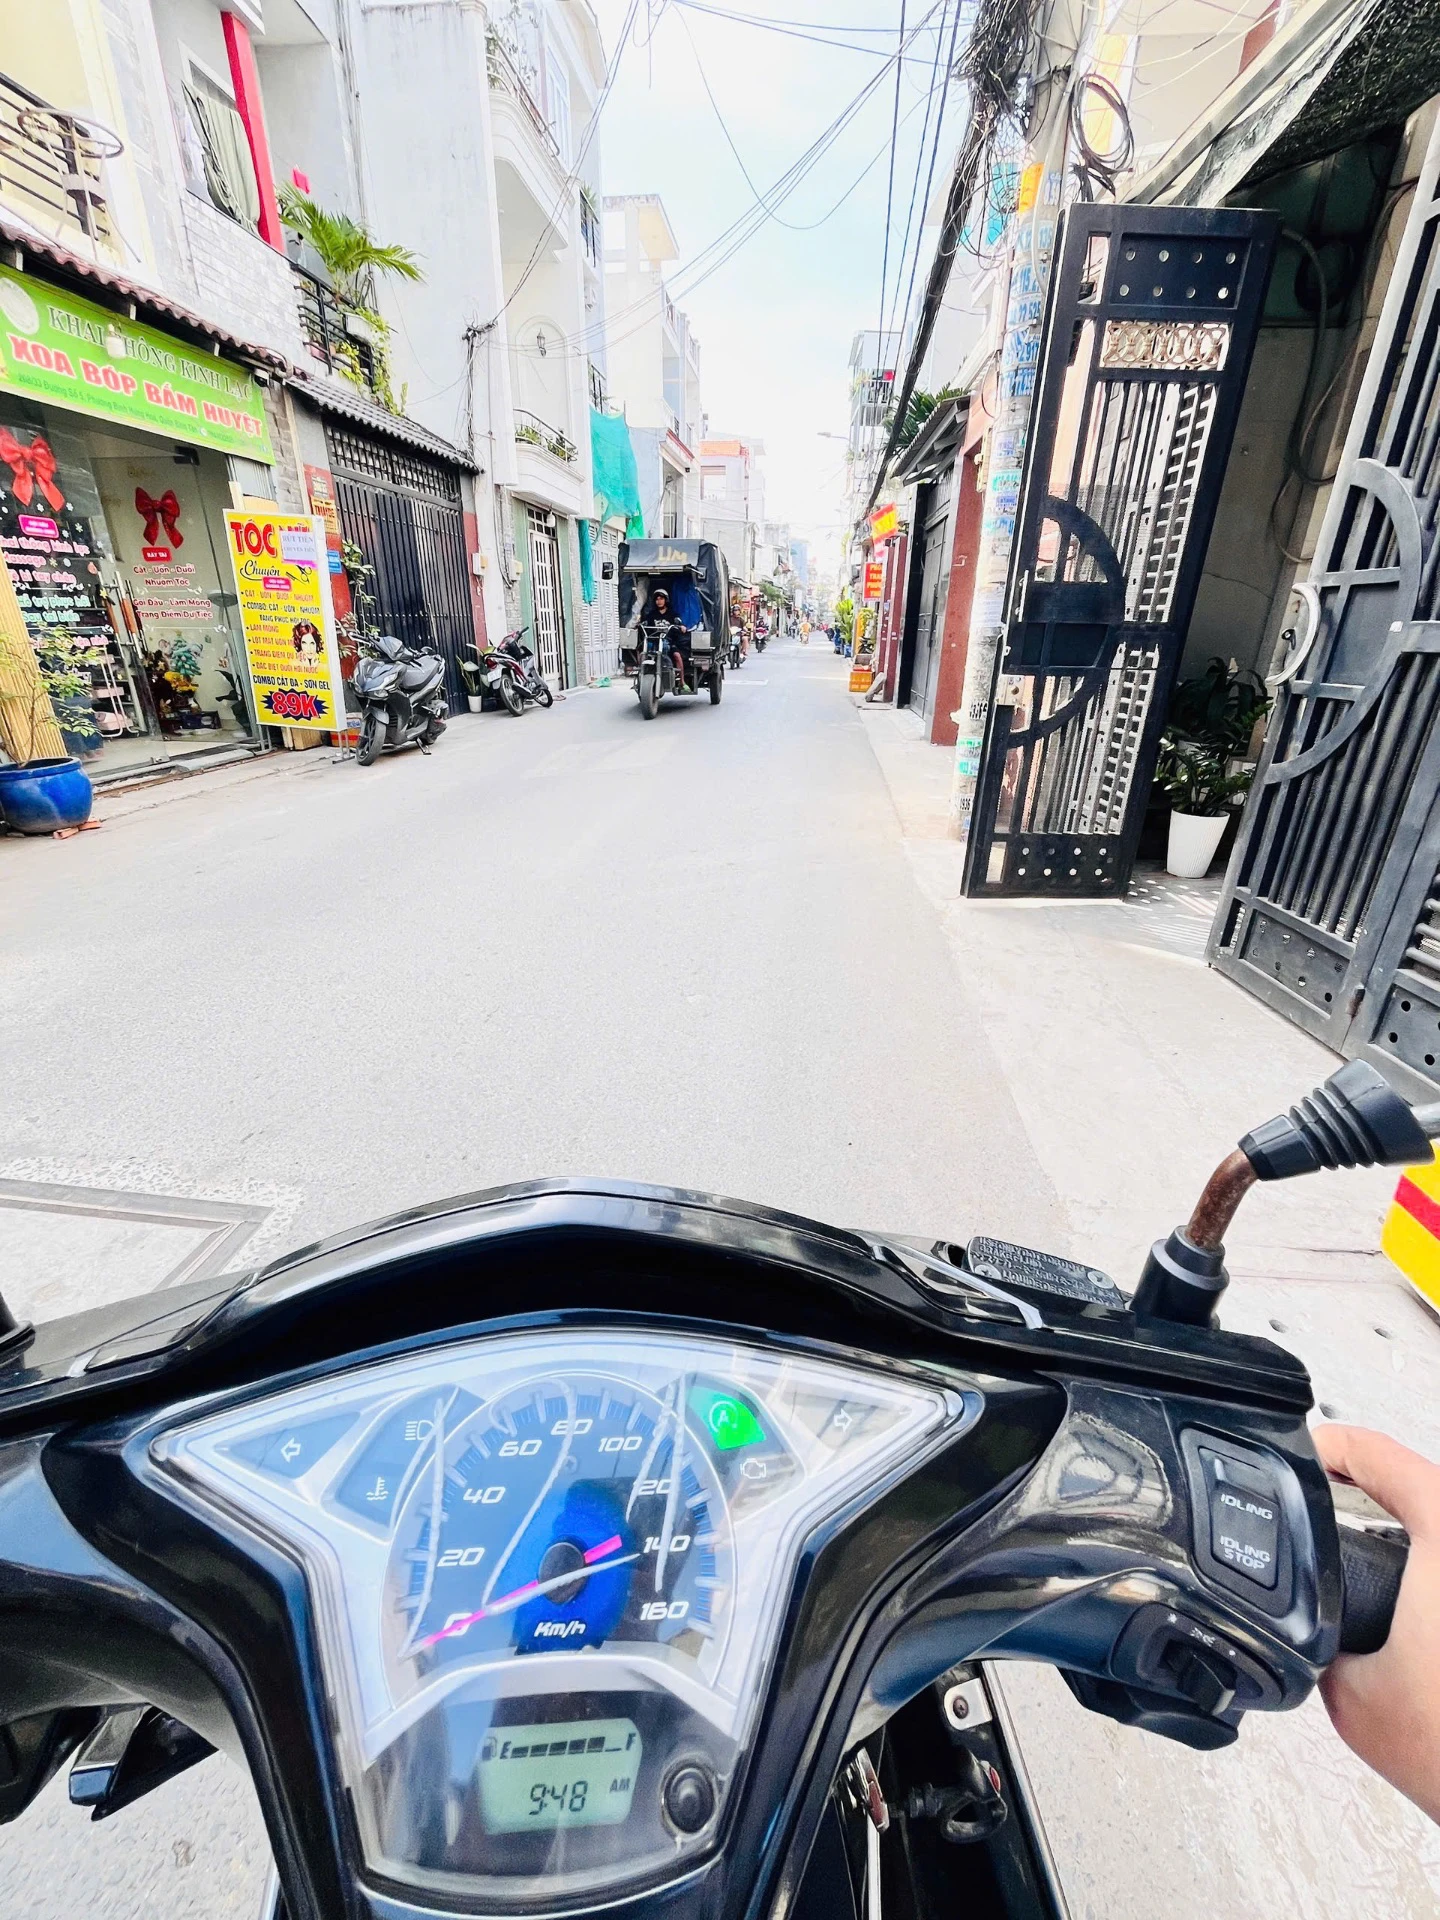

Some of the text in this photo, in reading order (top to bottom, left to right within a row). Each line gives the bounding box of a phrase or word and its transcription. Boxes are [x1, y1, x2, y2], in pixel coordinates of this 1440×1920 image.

[49, 306, 104, 347] KHAI
[115, 332, 176, 373] HÔNG
[180, 358, 221, 391] KINH
[7, 332, 76, 378] XOA
[80, 357, 137, 396] BÓP
[201, 400, 262, 437] HUYỆT
[240, 560, 280, 581] Chuyên
[253, 675, 275, 685] COMBO
[319, 681, 330, 690] GEL
[272, 691, 319, 718] 89K
[550, 1418, 594, 1436] 80
[498, 1439, 542, 1457] 60
[597, 1436, 643, 1453] 100
[462, 1486, 506, 1504] 40
[1220, 1493, 1273, 1521] IDLING
[642, 1534, 691, 1554] 140
[1220, 1534, 1271, 1563] IDLING
[437, 1546, 485, 1567] 20
[1223, 1548, 1265, 1570] STOP
[640, 1600, 690, 1621] 160
[442, 1612, 474, 1637] 0
[533, 1620, 587, 1638] Km/h
[499, 1741, 512, 1760] E
[626, 1733, 637, 1751] F
[609, 1777, 630, 1795] AM
[528, 1780, 589, 1816] 9:48
